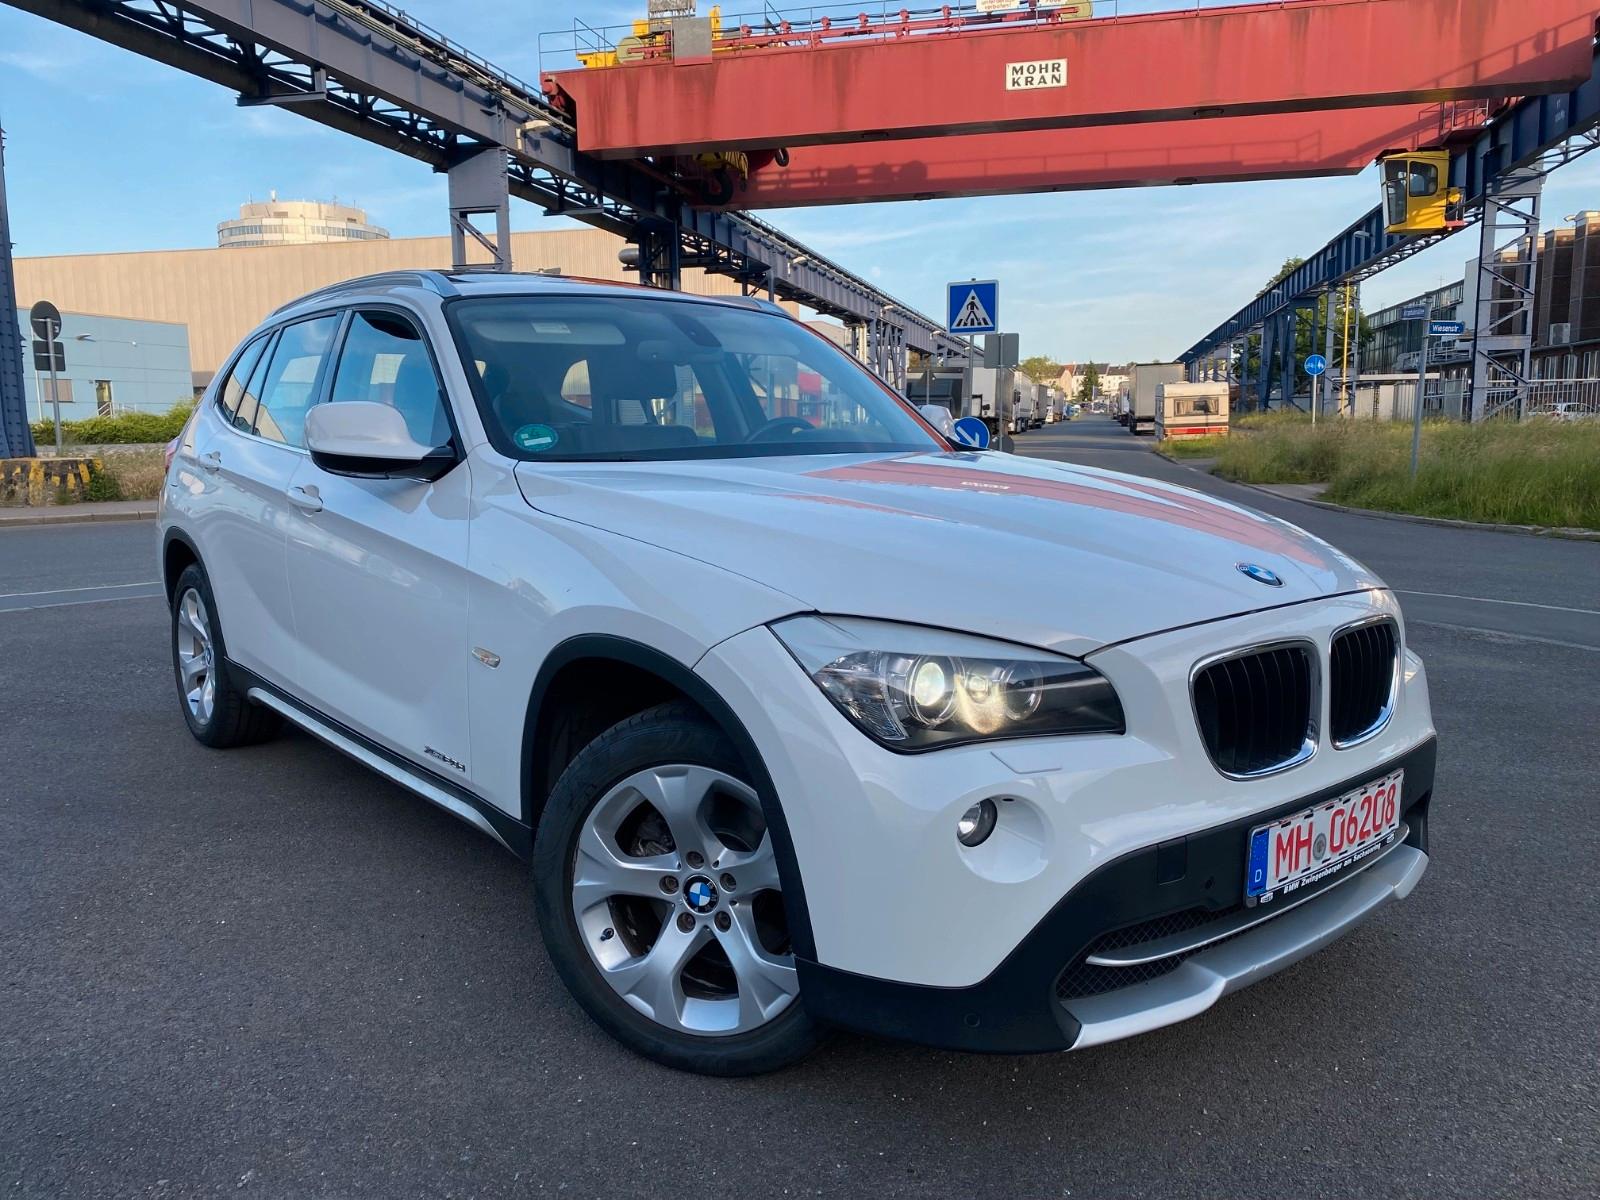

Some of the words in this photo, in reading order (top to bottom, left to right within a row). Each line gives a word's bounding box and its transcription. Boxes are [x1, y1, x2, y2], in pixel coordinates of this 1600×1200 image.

[1011, 62, 1061, 76] MOHR
[1011, 73, 1061, 87] KRAN
[1432, 324, 1460, 332] Wiesenstr.
[1254, 869, 1262, 883] D
[1275, 822, 1313, 879] MH
[1330, 783, 1396, 853] 06208
[1283, 880, 1300, 894] BMW
